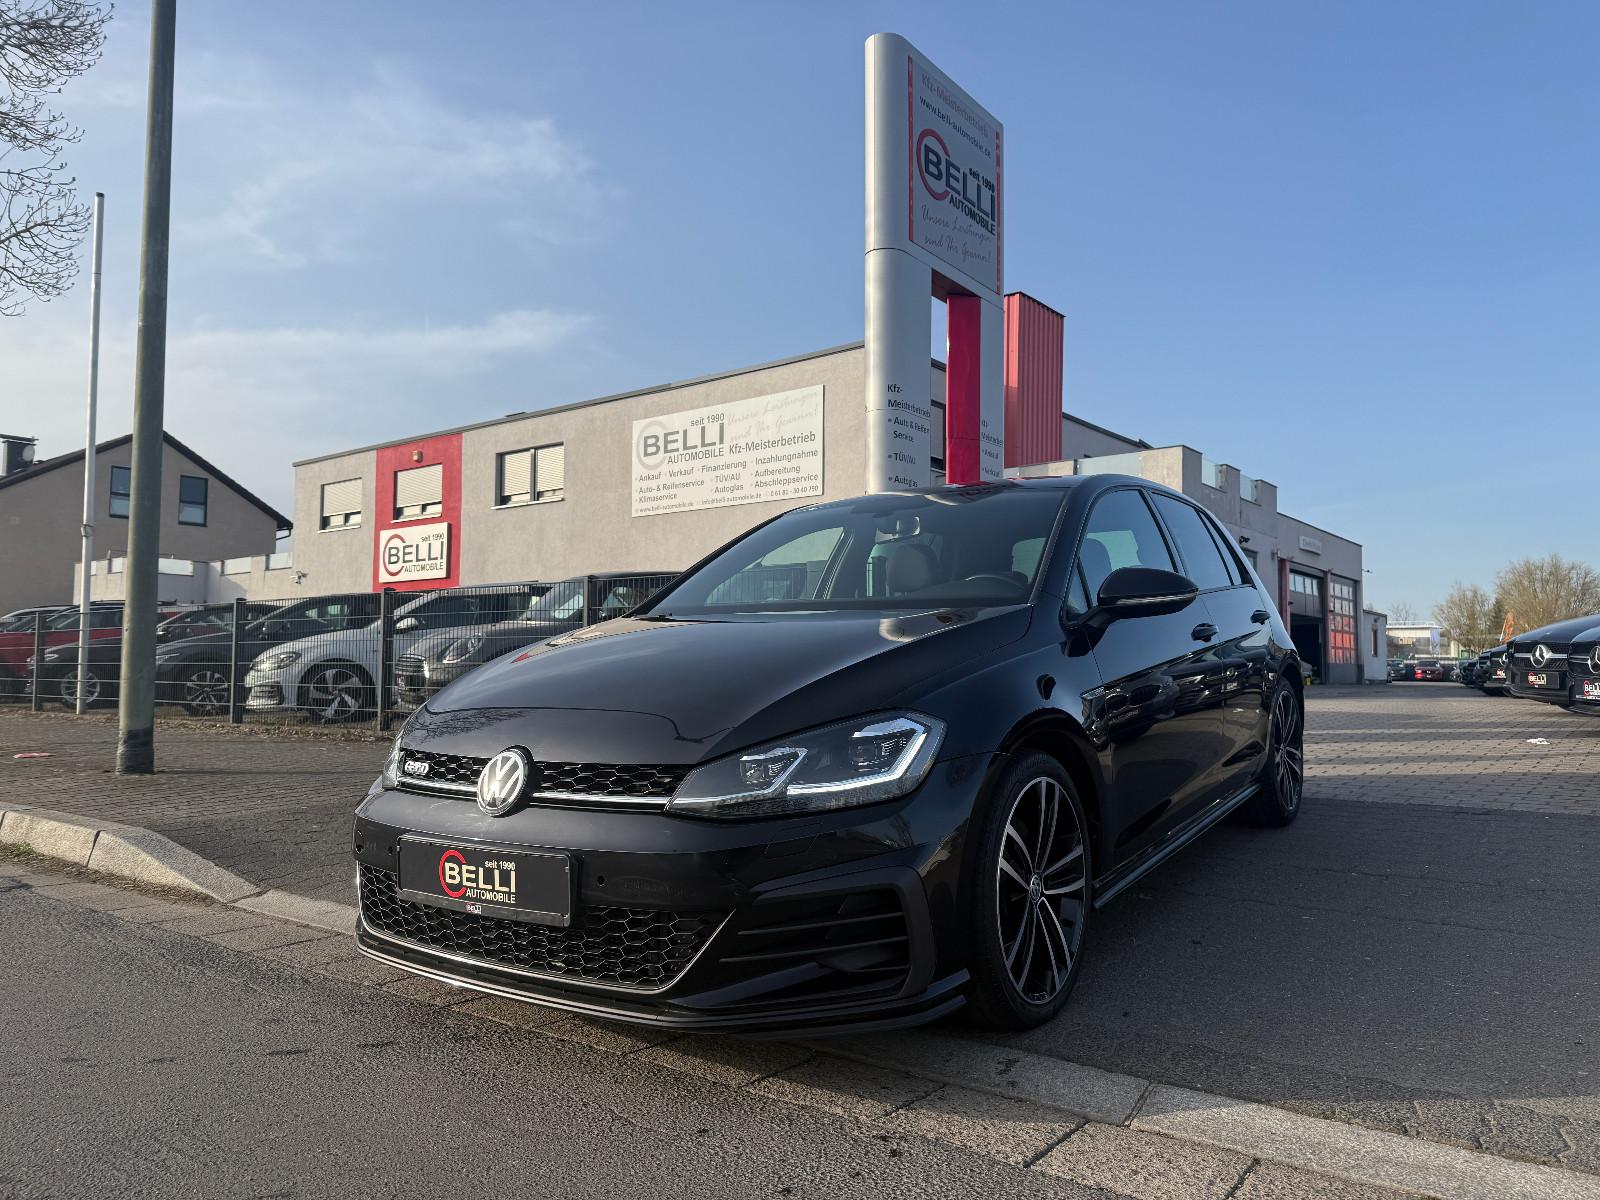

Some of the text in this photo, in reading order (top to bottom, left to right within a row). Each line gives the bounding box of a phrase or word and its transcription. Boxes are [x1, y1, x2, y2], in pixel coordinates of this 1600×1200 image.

[924, 144, 996, 222] BELLI
[950, 194, 996, 236] AUTOMOBILE
[888, 384, 904, 394] Kfz-
[690, 412, 724, 427] seit 1990
[643, 422, 724, 458] BELLI
[729, 431, 816, 455] Kfz-Meisterbetrieb
[639, 449, 818, 483] Ankauf Verkauf Finanzierung Inzahlungnahme
[667, 447, 724, 465] AUTOMOBILE
[639, 485, 655, 495] Auto-
[662, 480, 704, 491] Reifenservice
[754, 466, 800, 477] Aufbereitung
[639, 474, 818, 503] Klimaservice Autoglas Abschleppservice
[388, 541, 444, 564] BELLI
[404, 562, 444, 573] AUTOMOBILE
[445, 862, 516, 892] BELLI
[485, 860, 516, 870] seit 1990
[466, 888, 516, 903] AUTOMOBILE
